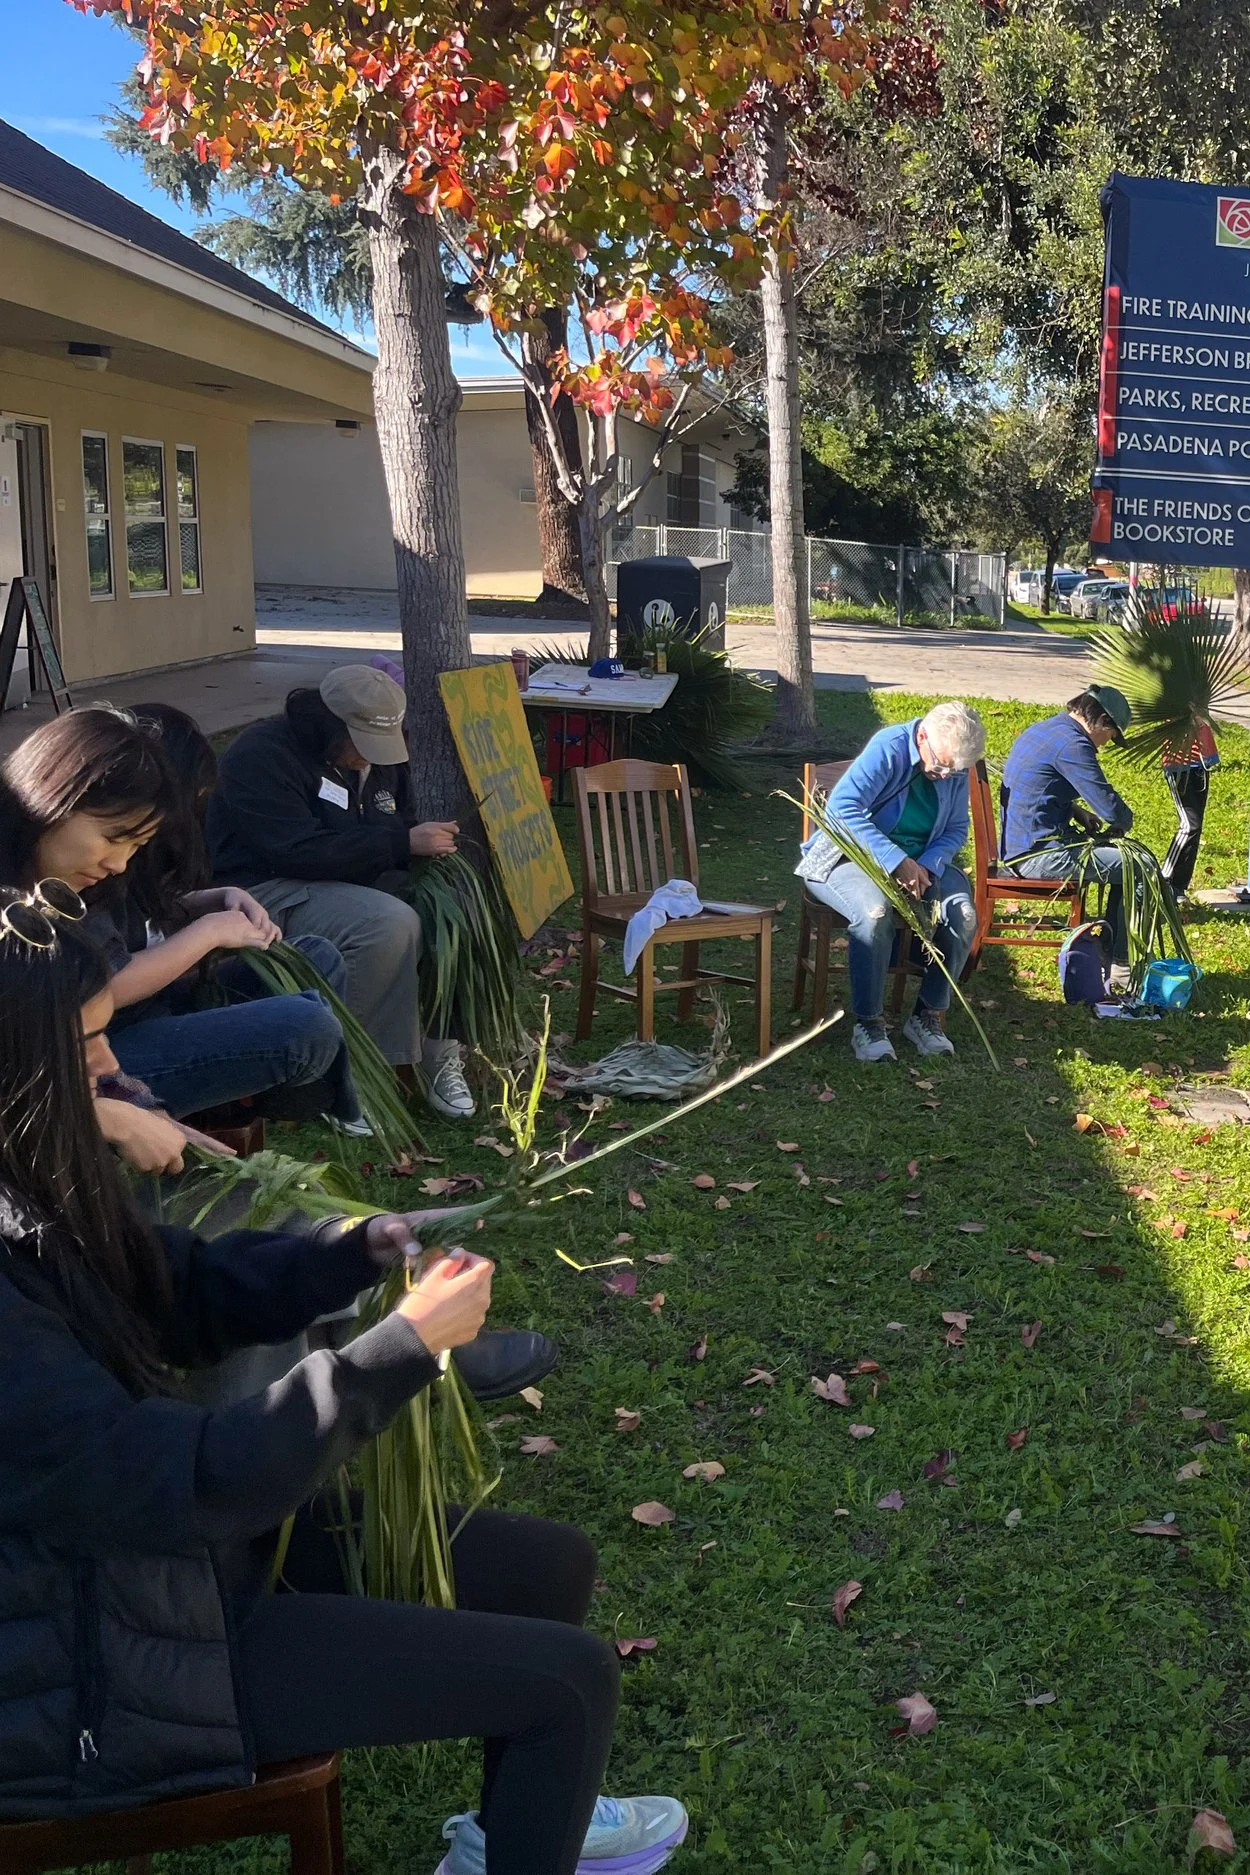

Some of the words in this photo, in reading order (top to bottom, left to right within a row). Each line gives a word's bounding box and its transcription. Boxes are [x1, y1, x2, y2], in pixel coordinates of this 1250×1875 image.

[1123, 296, 1162, 317] FIRE
[1120, 341, 1229, 368] JEFFERSON
[1119, 387, 1186, 412] PARKS,
[1117, 432, 1224, 456] PASADENA
[1115, 497, 1148, 516] THE
[1154, 500, 1232, 521] FRIENDS
[1114, 522, 1234, 546] BOOKSTORE
[462, 717, 500, 766] SIDE
[498, 809, 554, 870] PROJECTS
